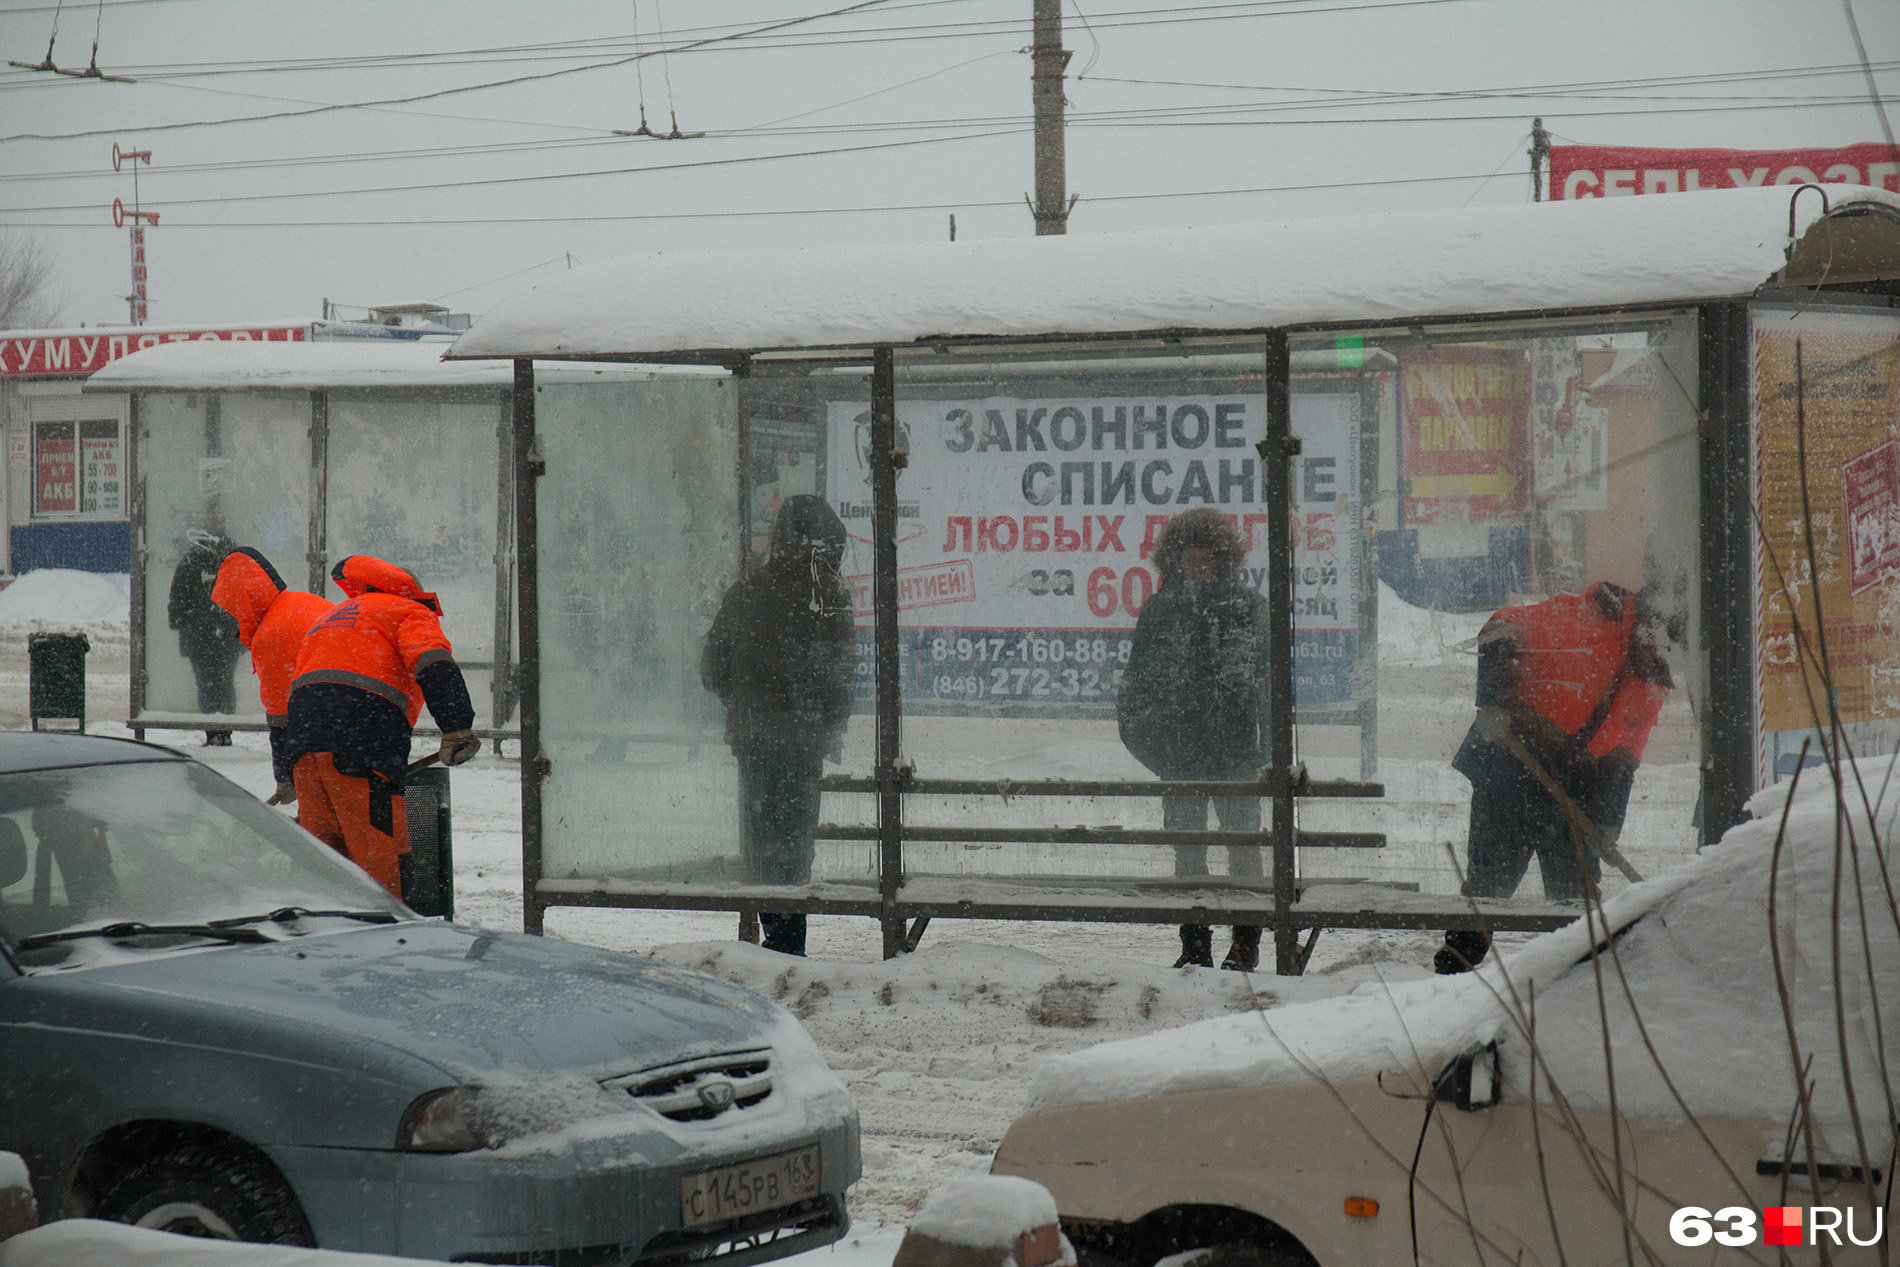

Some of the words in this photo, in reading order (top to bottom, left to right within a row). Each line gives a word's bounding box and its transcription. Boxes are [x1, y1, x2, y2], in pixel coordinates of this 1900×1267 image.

[945, 402, 1246, 453] ЗАКОННОЕ
[43, 482, 74, 500] АКБ
[943, 515, 1127, 554] ЛЮБЫХ
[933, 675, 985, 698] (846)
